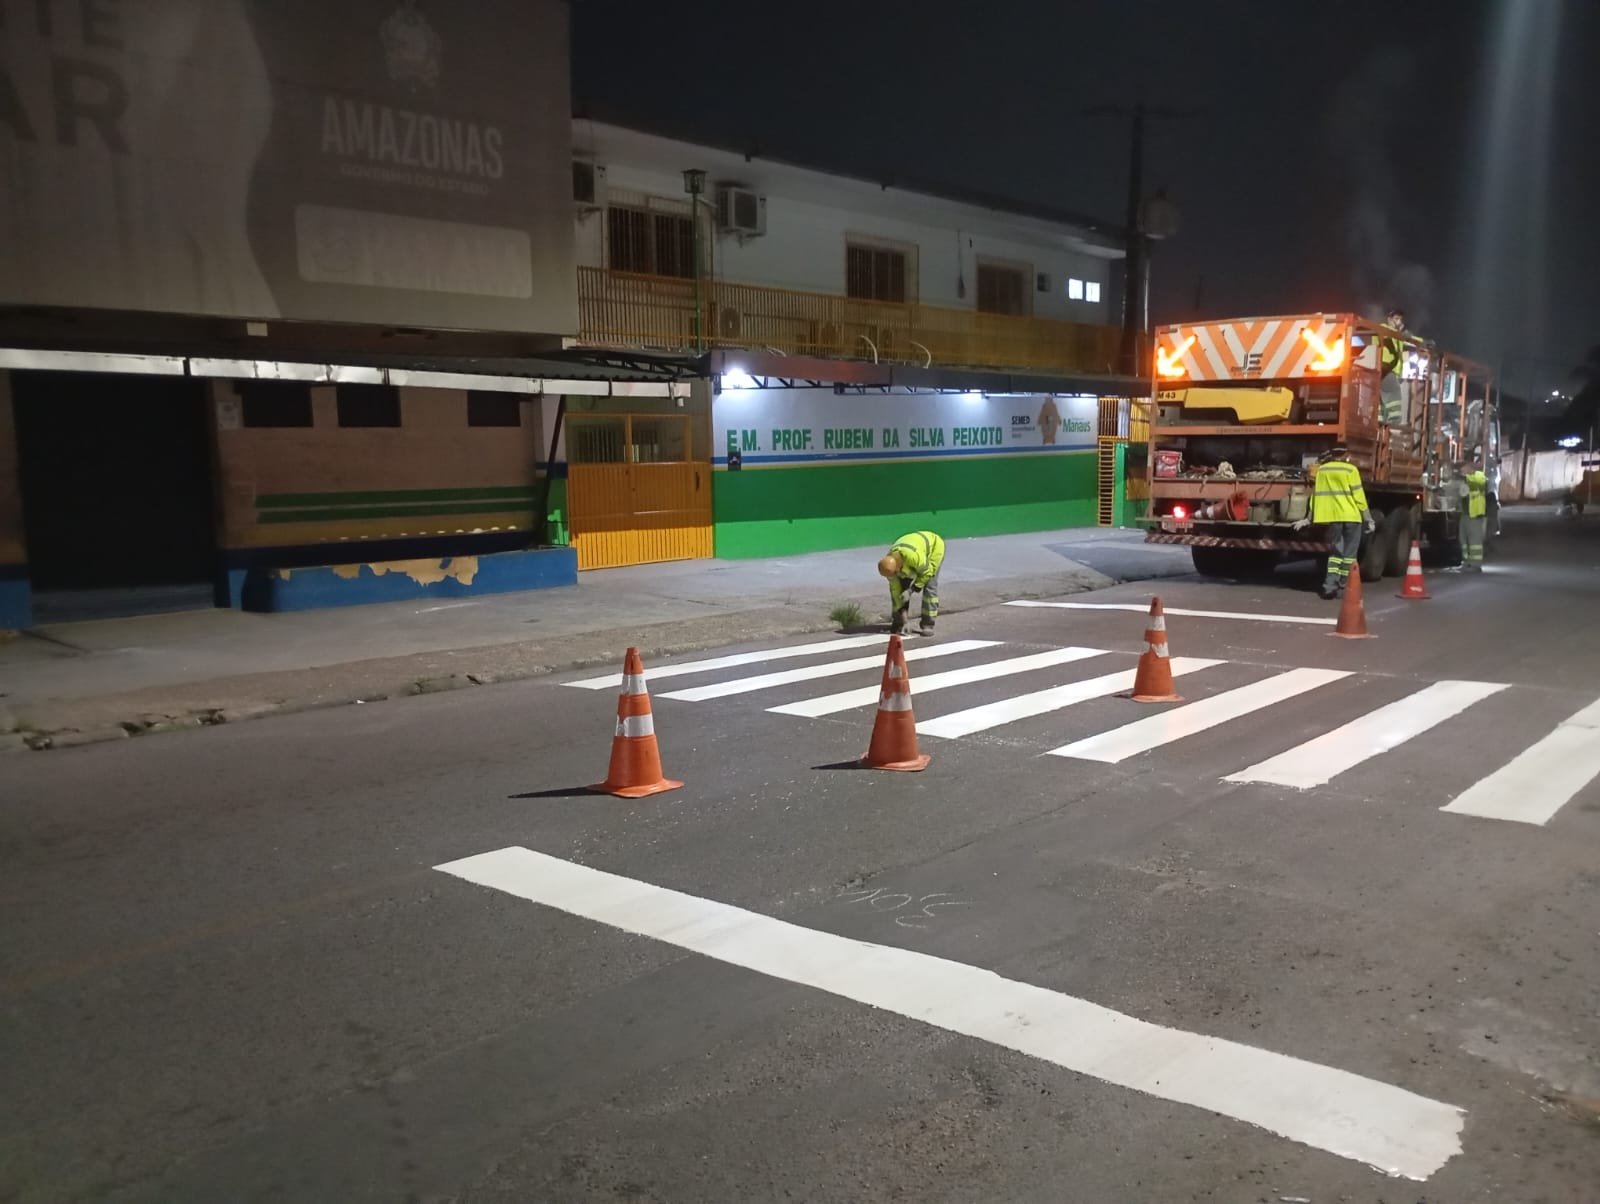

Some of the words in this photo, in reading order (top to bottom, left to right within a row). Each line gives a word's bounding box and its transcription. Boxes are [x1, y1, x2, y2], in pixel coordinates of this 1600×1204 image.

[321, 95, 504, 179] AMAZONAS
[1011, 415, 1031, 426] SEMED
[1062, 418, 1091, 433] Manaus
[726, 429, 761, 452] E.M.
[772, 428, 815, 451] PROF.
[824, 427, 874, 449] RUBEM
[883, 427, 899, 448] DA
[909, 427, 944, 448] SILVA
[952, 426, 1003, 447] PEIXOTO
